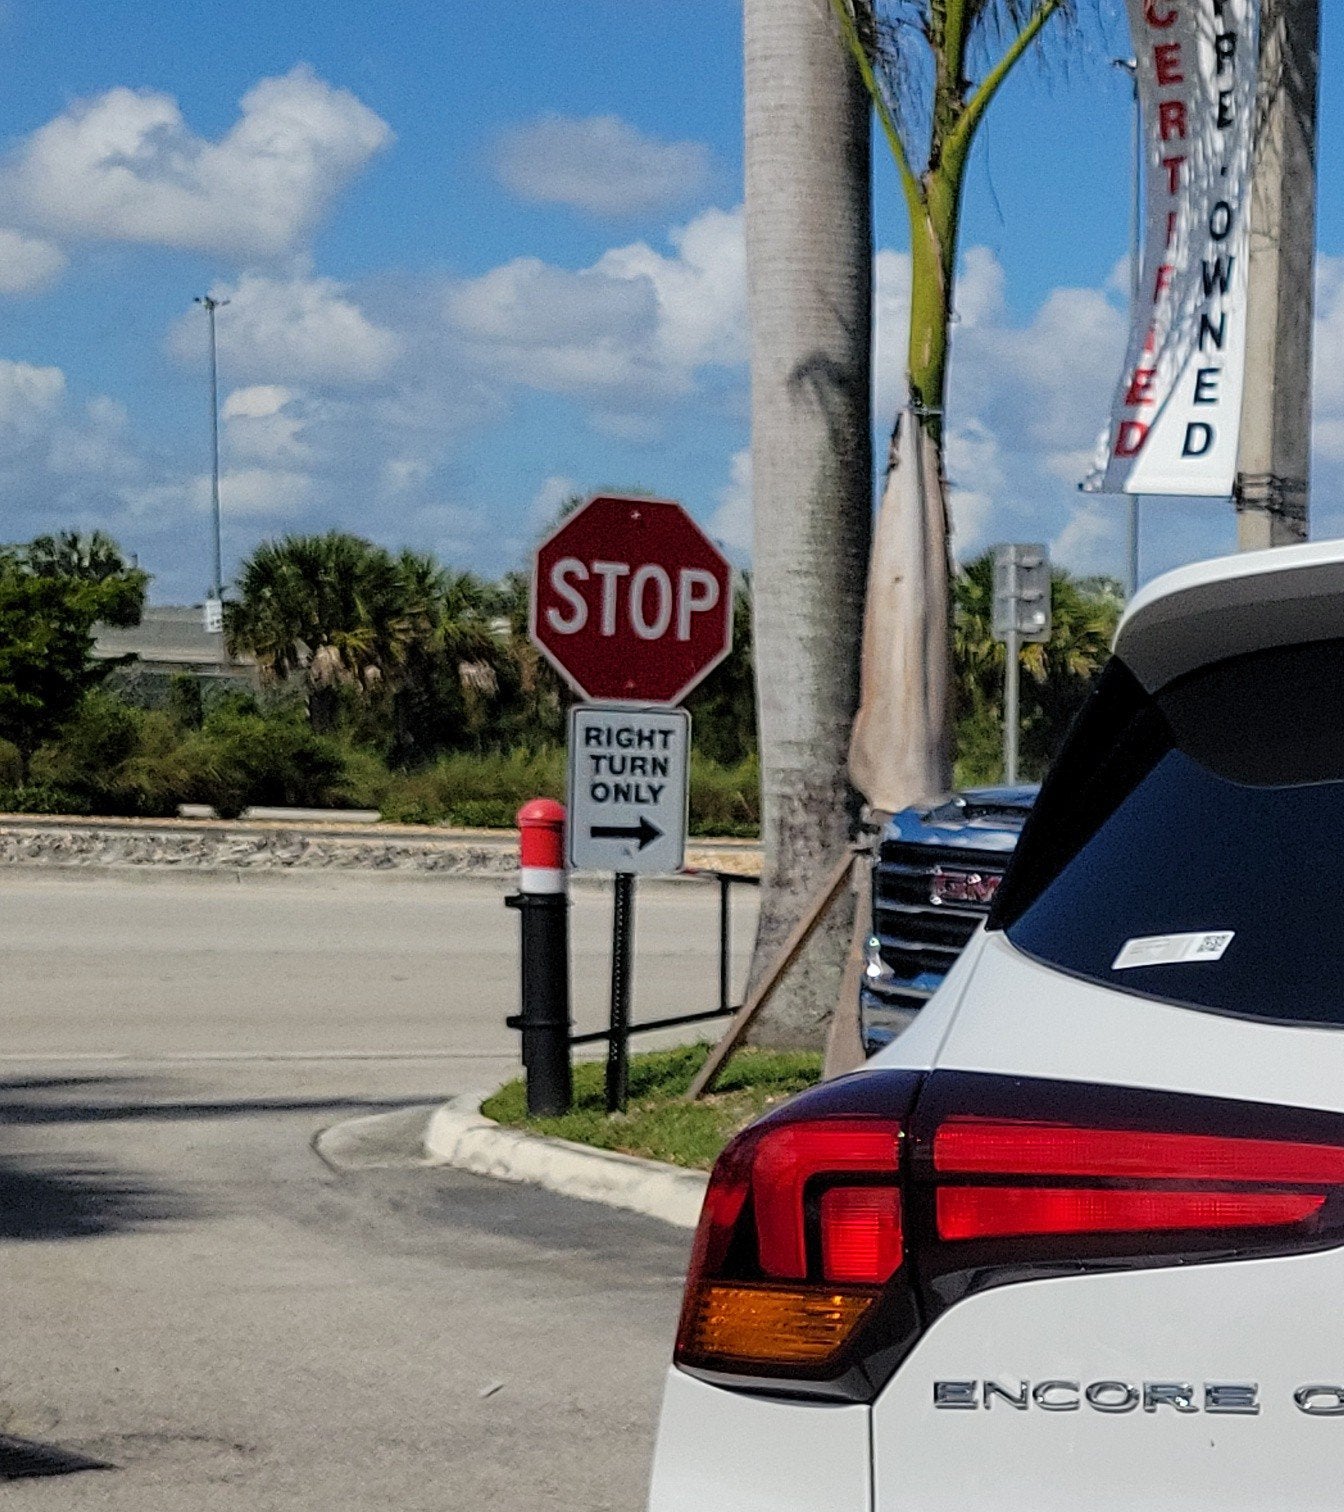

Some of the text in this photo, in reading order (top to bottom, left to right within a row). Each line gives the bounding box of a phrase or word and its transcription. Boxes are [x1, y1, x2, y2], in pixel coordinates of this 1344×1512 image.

[546, 557, 720, 641] STOP
[585, 727, 676, 748] RIGHT
[591, 754, 668, 776] TURN
[590, 782, 665, 804] ONLY
[933, 1380, 1260, 1415] ENCORE
